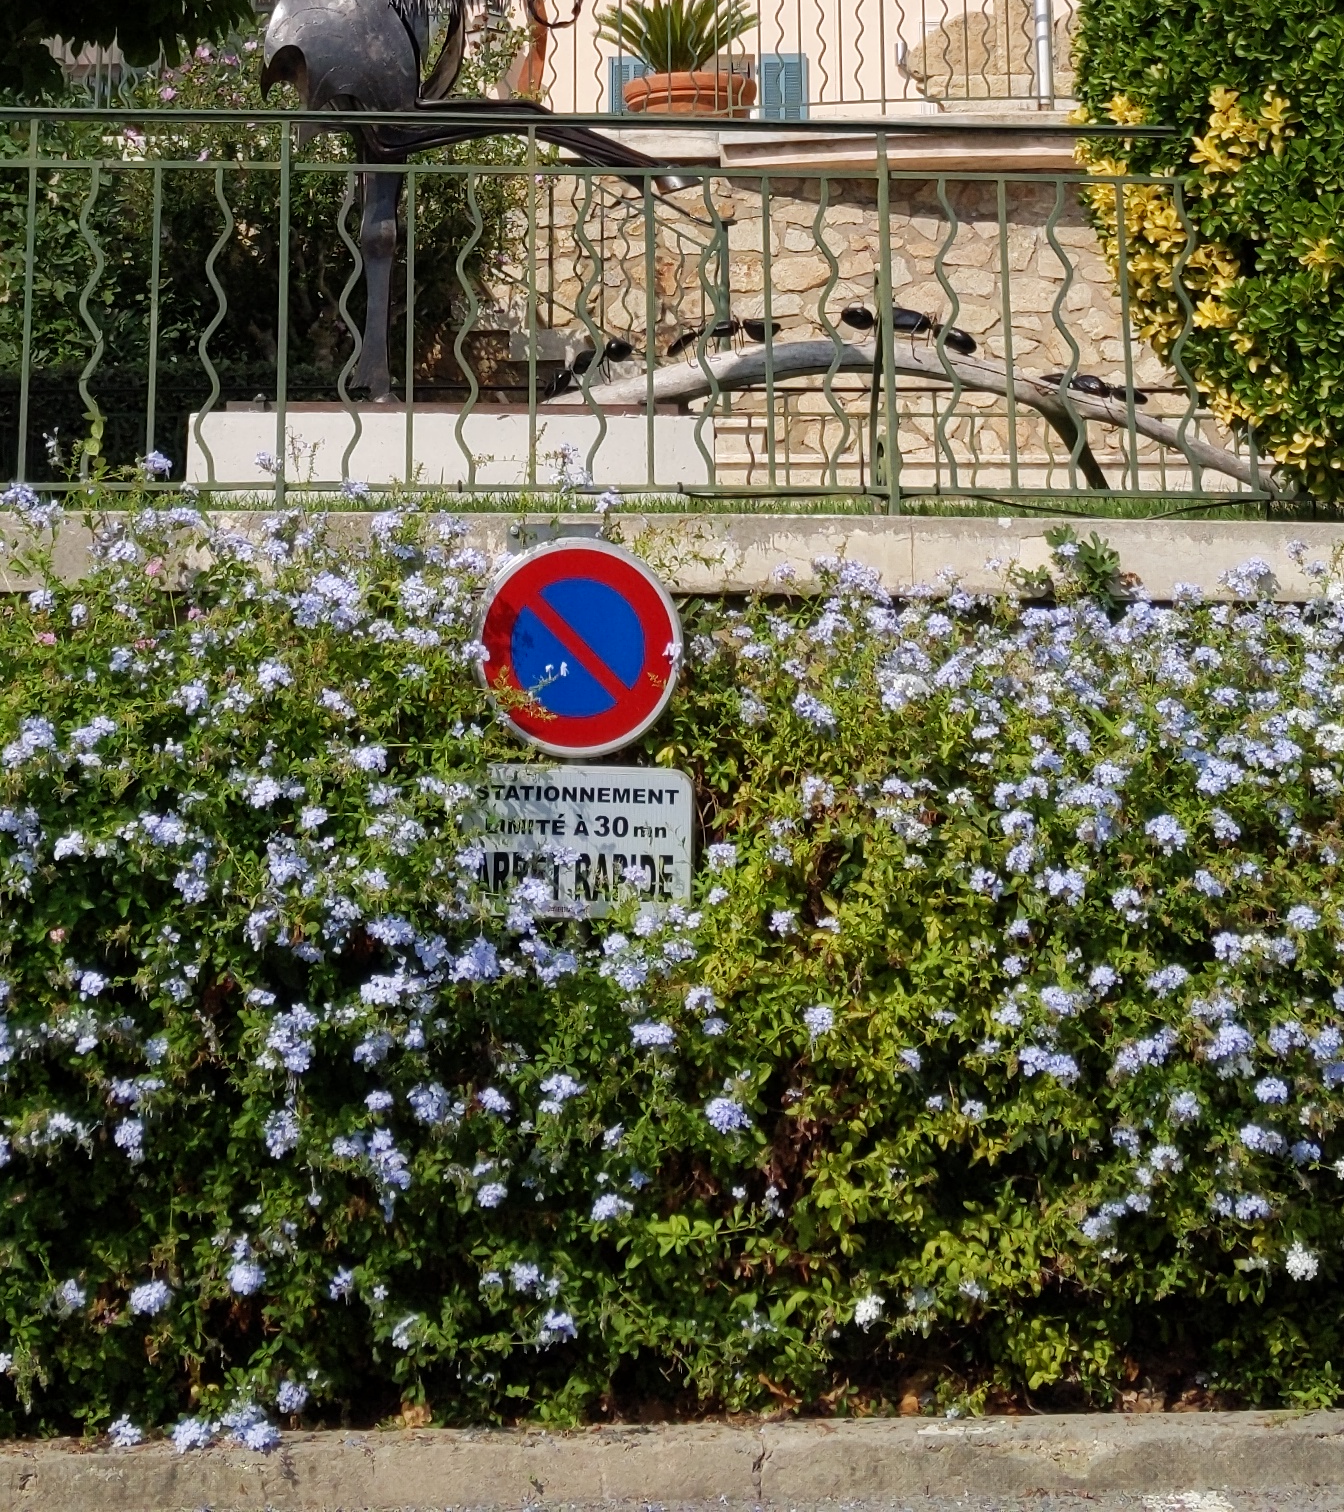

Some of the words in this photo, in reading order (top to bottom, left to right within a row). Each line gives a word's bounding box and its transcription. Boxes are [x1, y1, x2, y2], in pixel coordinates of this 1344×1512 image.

[477, 785, 680, 805] STATIONNEMENT
[574, 814, 589, 837] À
[594, 815, 629, 838] 30
